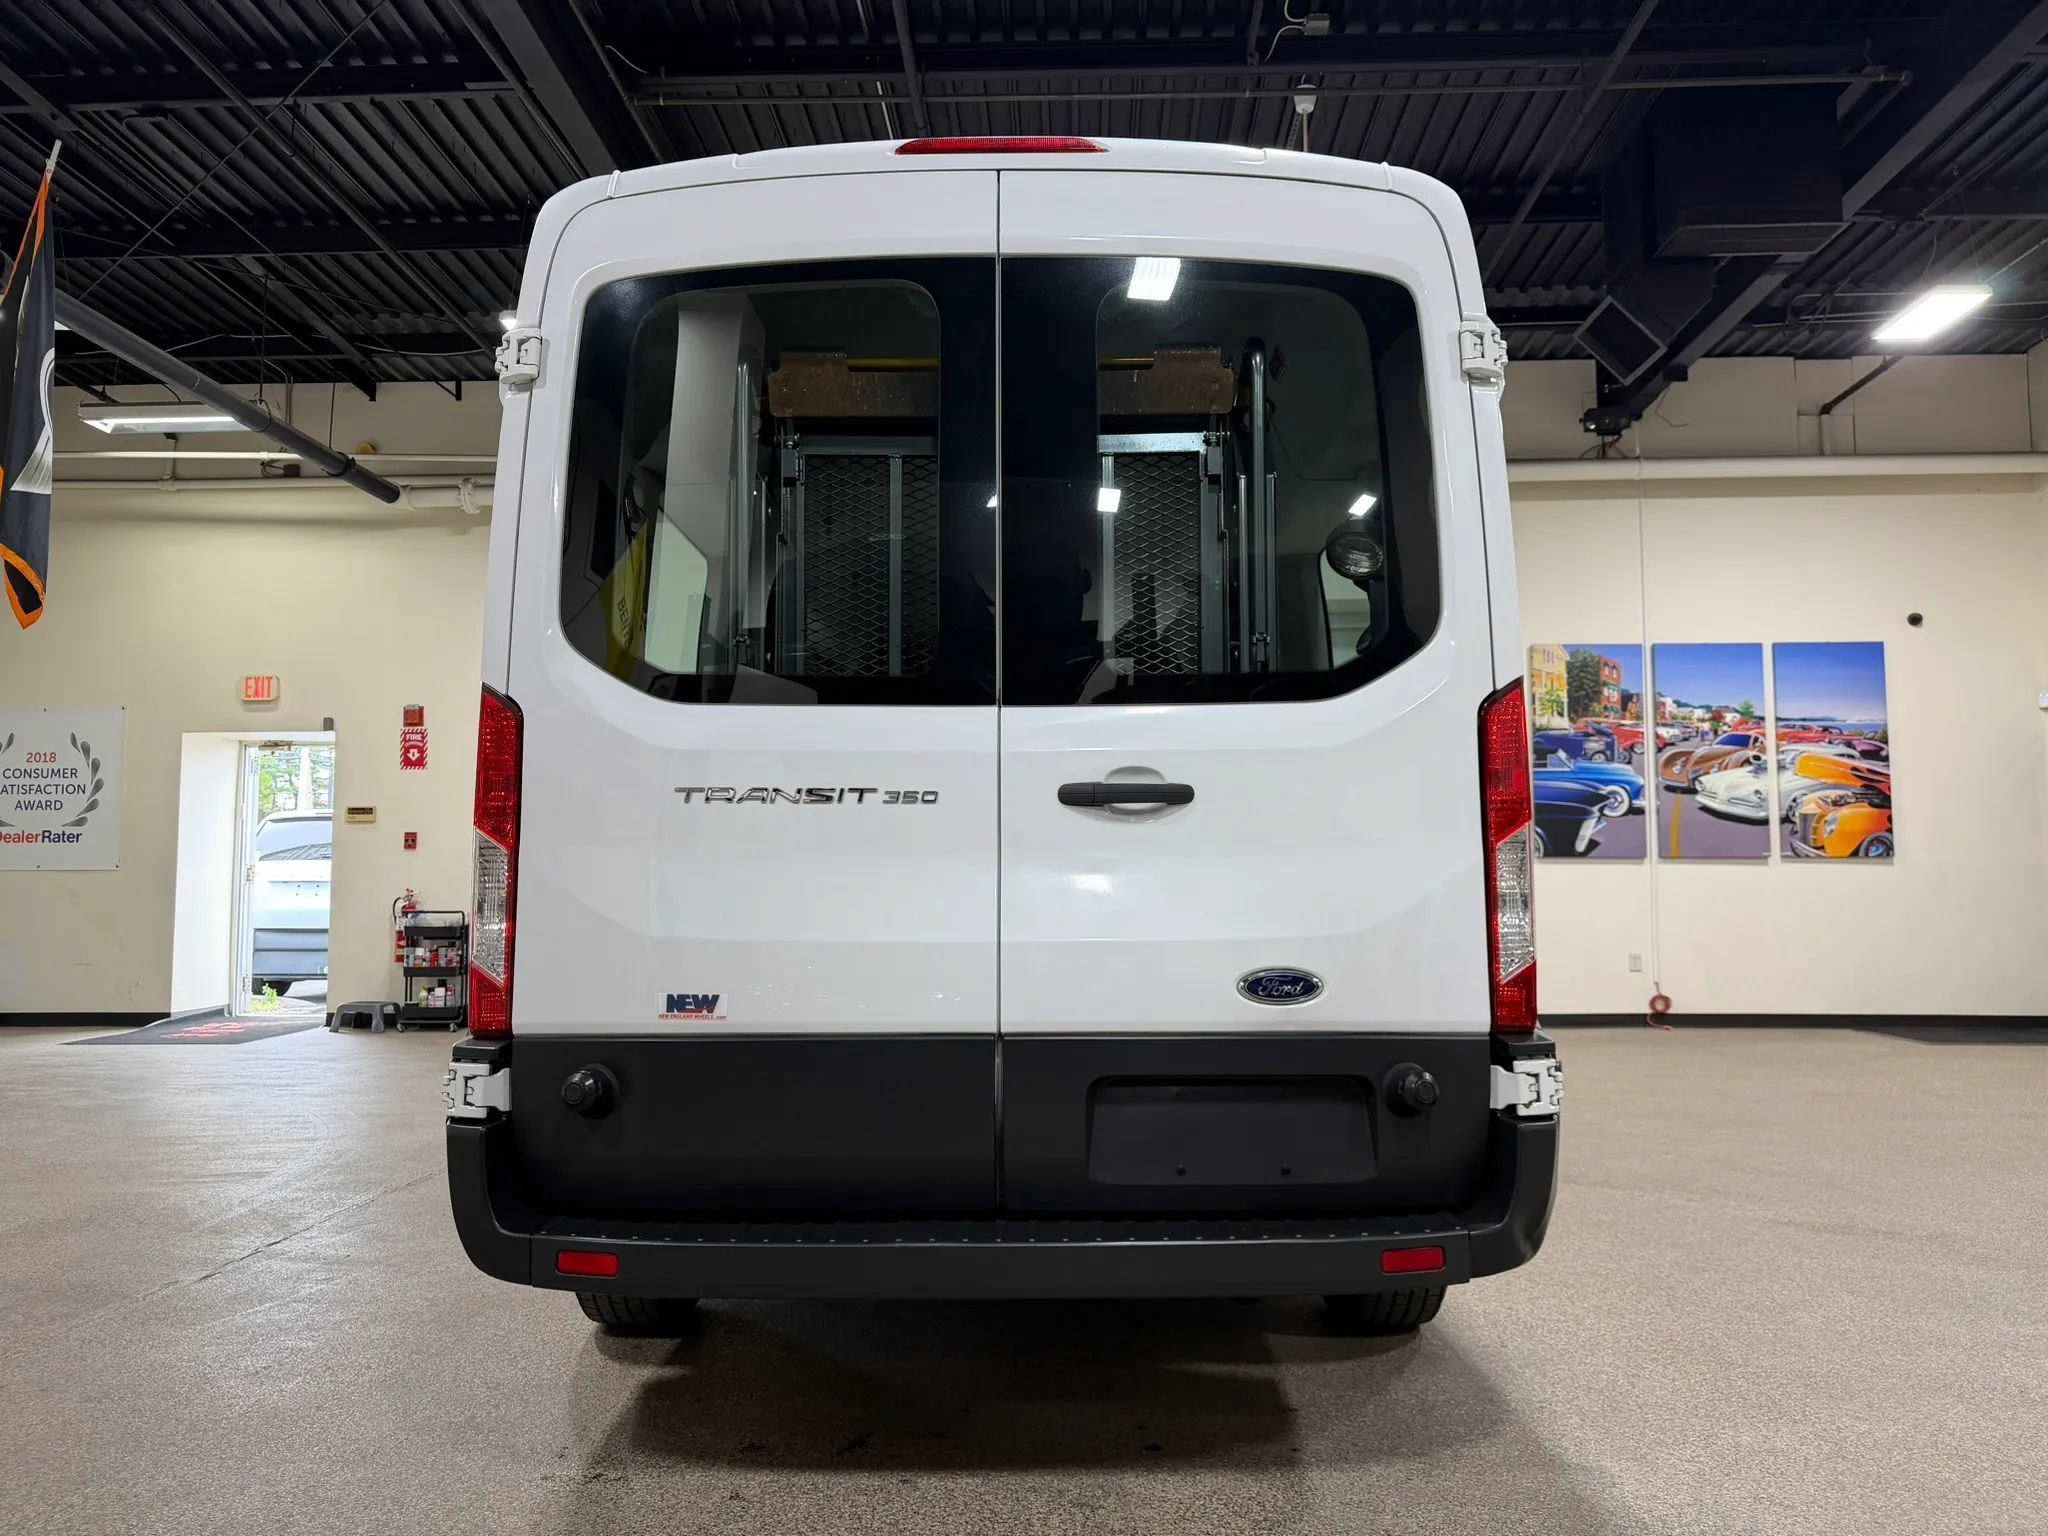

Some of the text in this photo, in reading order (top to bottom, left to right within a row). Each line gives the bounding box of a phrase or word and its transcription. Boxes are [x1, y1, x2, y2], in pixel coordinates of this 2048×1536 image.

[244, 676, 273, 699] EXIT
[405, 733, 423, 741] FIRE
[26, 752, 57, 763] 2018
[2, 768, 78, 779] CONSUMER
[0, 784, 86, 795] ATISFACTION
[674, 786, 939, 805] TRANSIT 350
[14, 800, 63, 811] AWARD
[1257, 976, 1305, 997] Ford
[666, 993, 720, 1014] NEW
